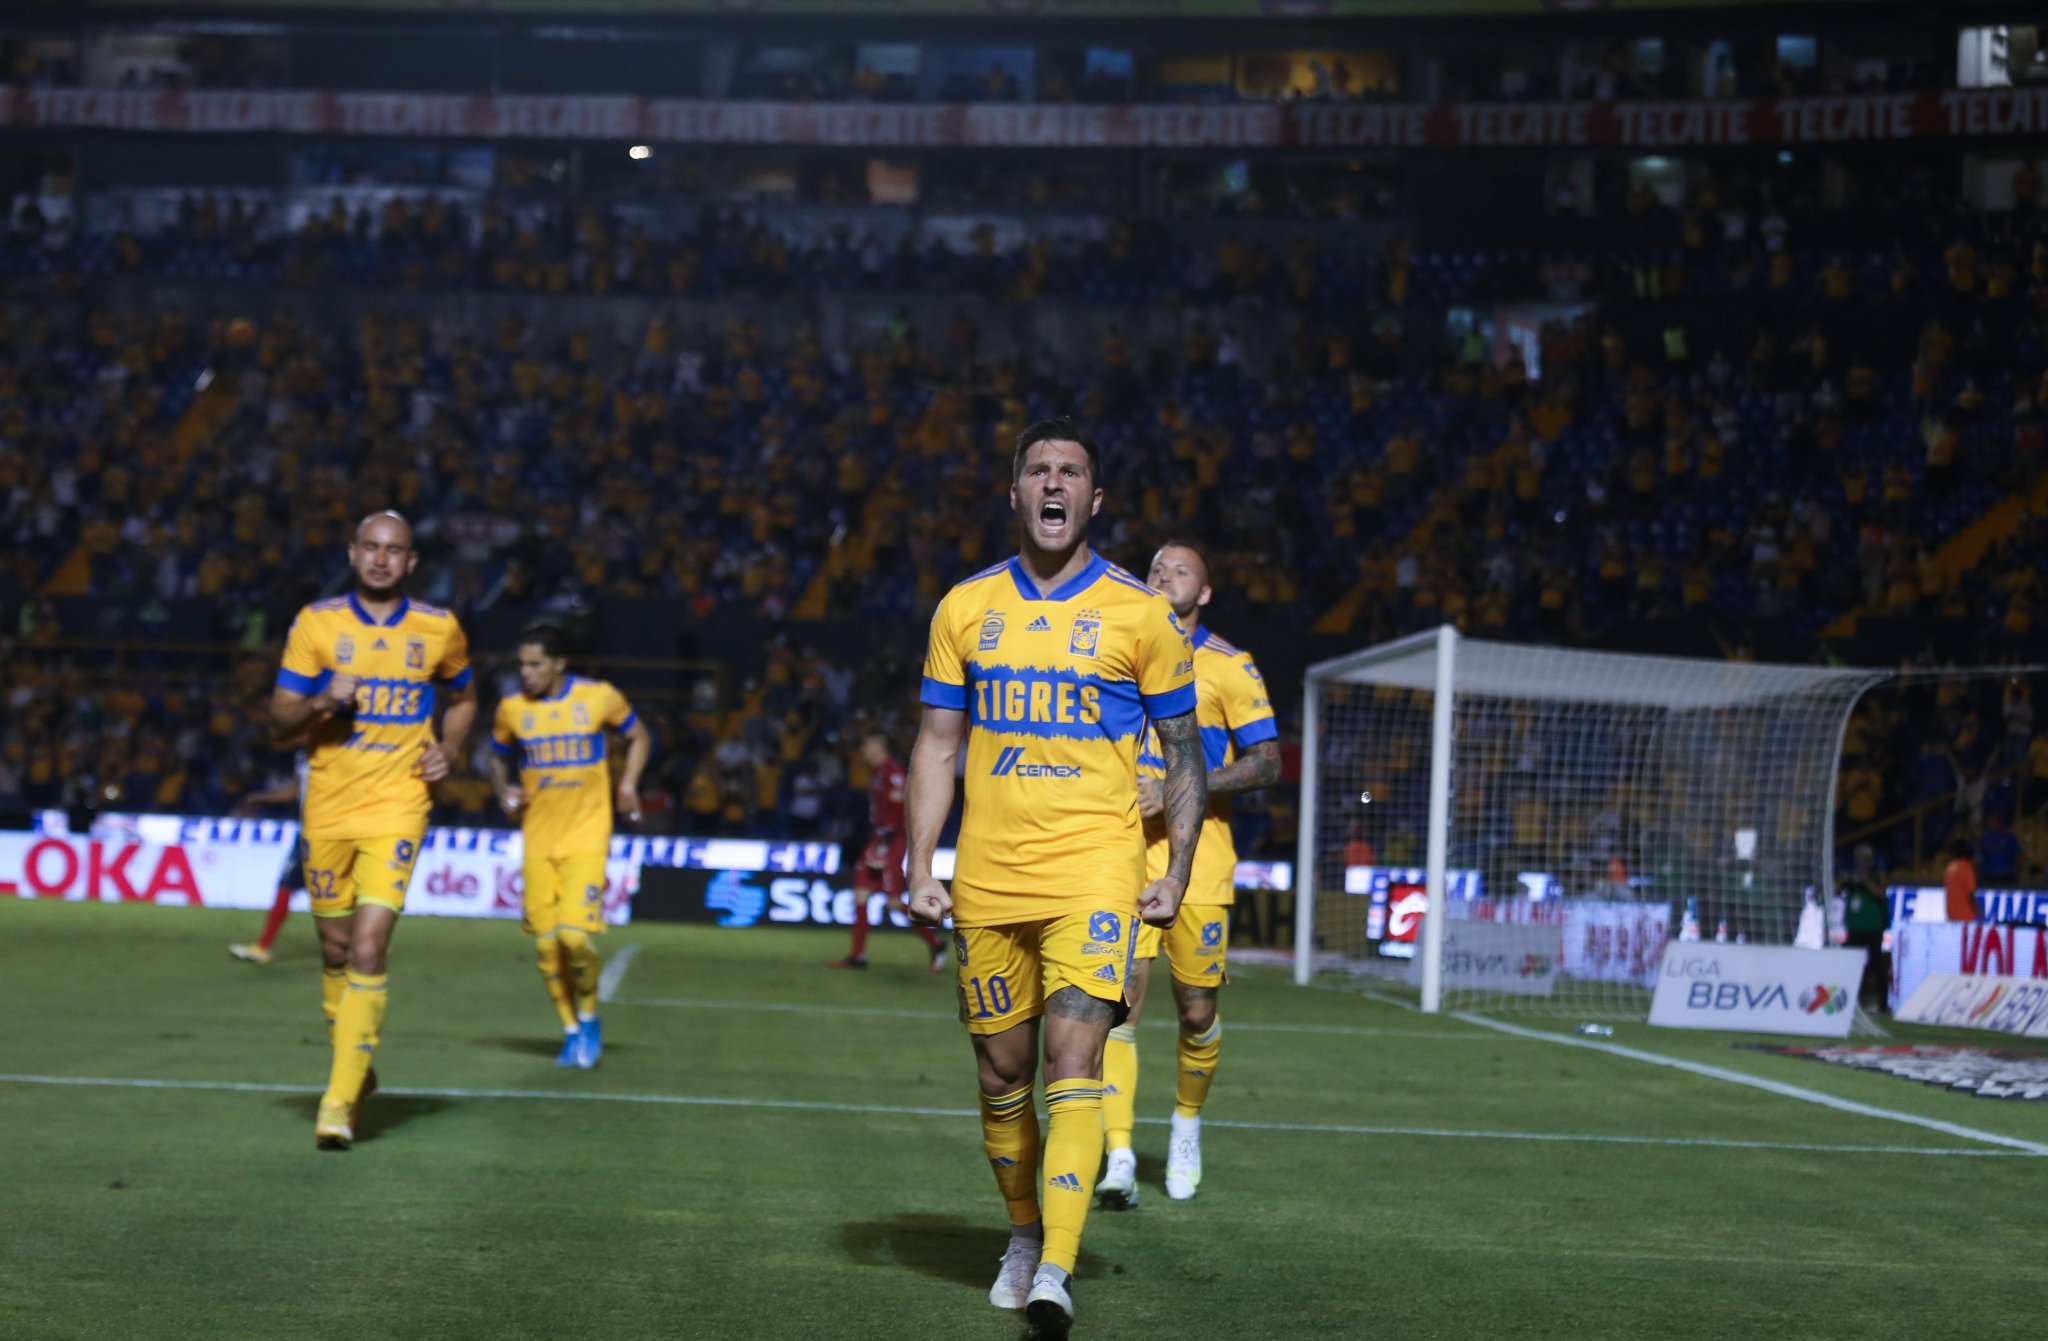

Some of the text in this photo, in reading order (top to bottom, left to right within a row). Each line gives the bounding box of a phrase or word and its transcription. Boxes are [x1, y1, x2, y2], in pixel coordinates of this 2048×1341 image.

[31, 90, 158, 129] TECATE
[336, 94, 470, 137] TECATE
[492, 96, 630, 139] TECATE
[648, 100, 785, 142] TECATE
[808, 102, 945, 145] TECATE
[966, 103, 1106, 146] TECATE
[1124, 104, 1265, 146] TECATE
[1288, 104, 1428, 146] TECATE
[1448, 103, 1592, 146] TECATE
[1608, 101, 1750, 146] TECATE
[1771, 95, 1912, 142] TECATE
[355, 684, 423, 717] GRES
[975, 680, 1102, 725] TIGRES
[1015, 764, 1082, 778] CEMEX
[0, 838, 204, 906] OKA
[309, 869, 338, 899] 32
[768, 877, 953, 930] Ster
[1665, 957, 1722, 979] LIGA
[970, 975, 1012, 1019] 10
[1687, 980, 1789, 1011] BBVA
[1988, 984, 2048, 1035] BBV
